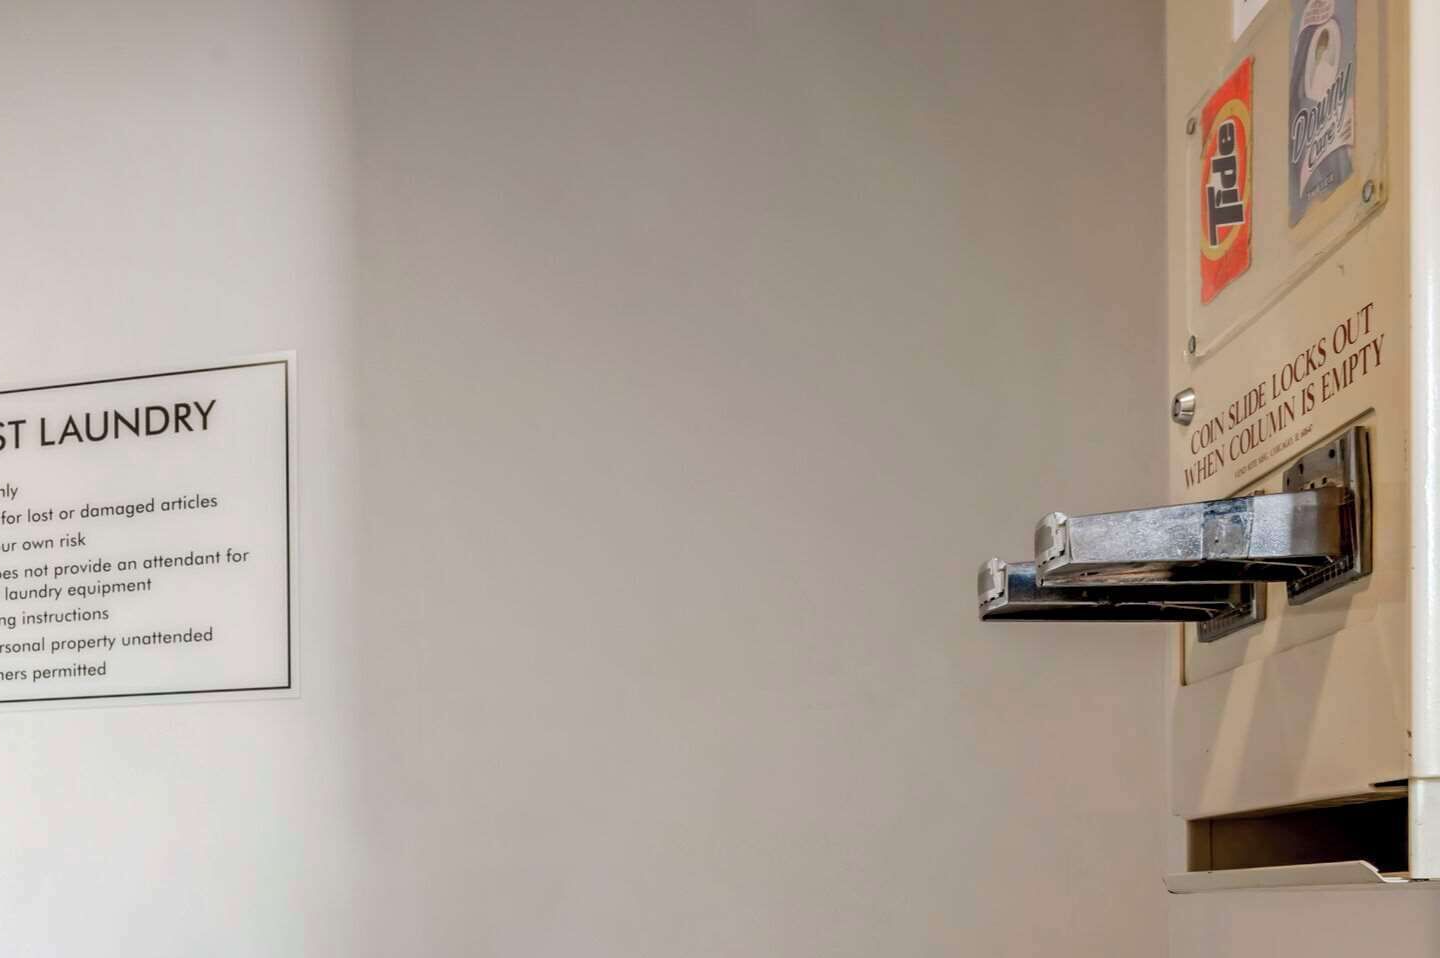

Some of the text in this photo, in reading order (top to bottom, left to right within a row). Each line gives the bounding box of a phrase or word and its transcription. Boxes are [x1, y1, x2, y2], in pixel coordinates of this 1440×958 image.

[1291, 62, 1352, 164] Downy
[1207, 121, 1245, 247] Tide
[1191, 412, 1224, 454] COIN
[1228, 382, 1267, 429] SLIDE
[1272, 338, 1327, 400] LOCKS
[1333, 302, 1374, 353] OUT
[40, 399, 216, 447] LAUNDRY
[1185, 443, 1225, 488] WHEN
[1230, 397, 1296, 461] COLUMN
[1302, 382, 1315, 415] IS
[1321, 334, 1384, 403] EMPTY
[1, 511, 22, 525] for
[27, 508, 53, 523] lost
[59, 506, 75, 520] or
[80, 499, 155, 522] damaged
[160, 495, 218, 512] articles
[22, 537, 54, 551] own
[60, 533, 86, 548] risk
[24, 565, 48, 578] not
[54, 559, 112, 581] provide
[117, 559, 137, 571] an
[143, 551, 221, 569] attendant
[226, 548, 249, 564] for
[5, 584, 61, 604] laundry
[67, 578, 152, 600] equipment
[22, 607, 109, 626] instructions
[51, 634, 116, 654] property
[121, 627, 213, 647] unattended
[32, 662, 107, 683] permitted
